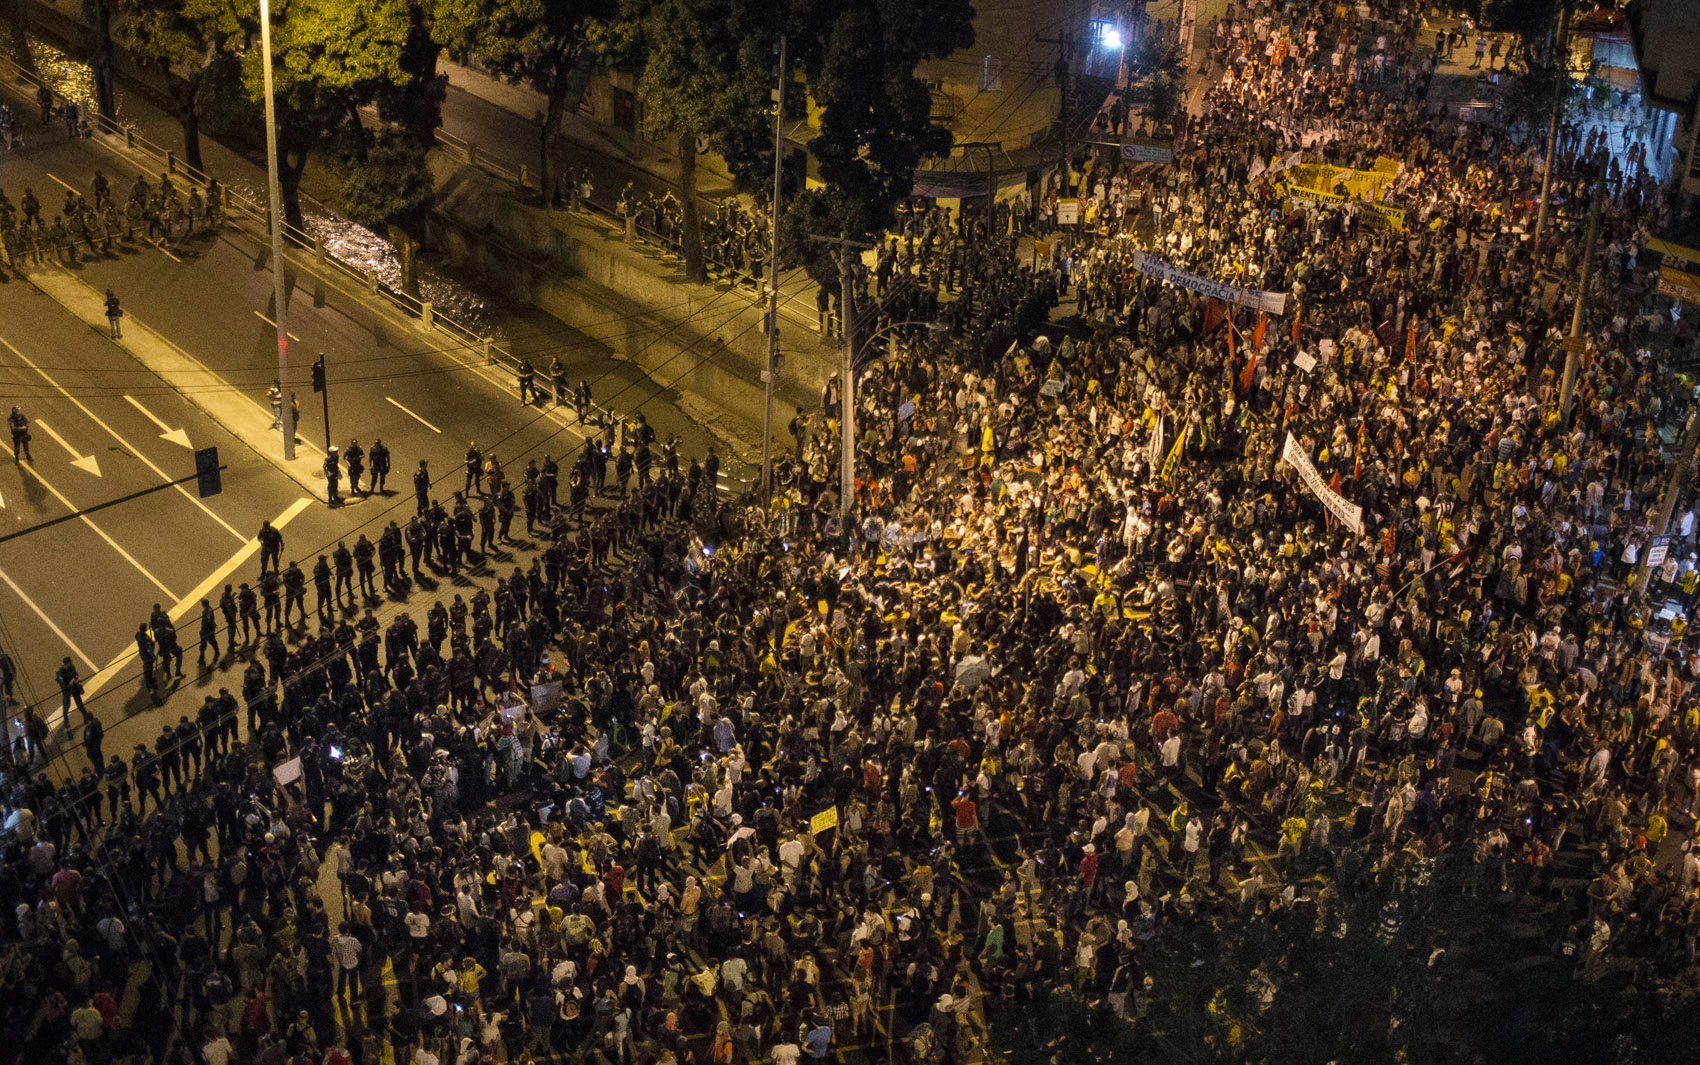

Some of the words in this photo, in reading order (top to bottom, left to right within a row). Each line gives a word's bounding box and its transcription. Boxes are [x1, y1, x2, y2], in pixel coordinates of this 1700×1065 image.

[1143, 253, 1165, 268] VIVA
[1140, 262, 1165, 279] NOVA
[1169, 273, 1235, 301] DEMOCRACIA
